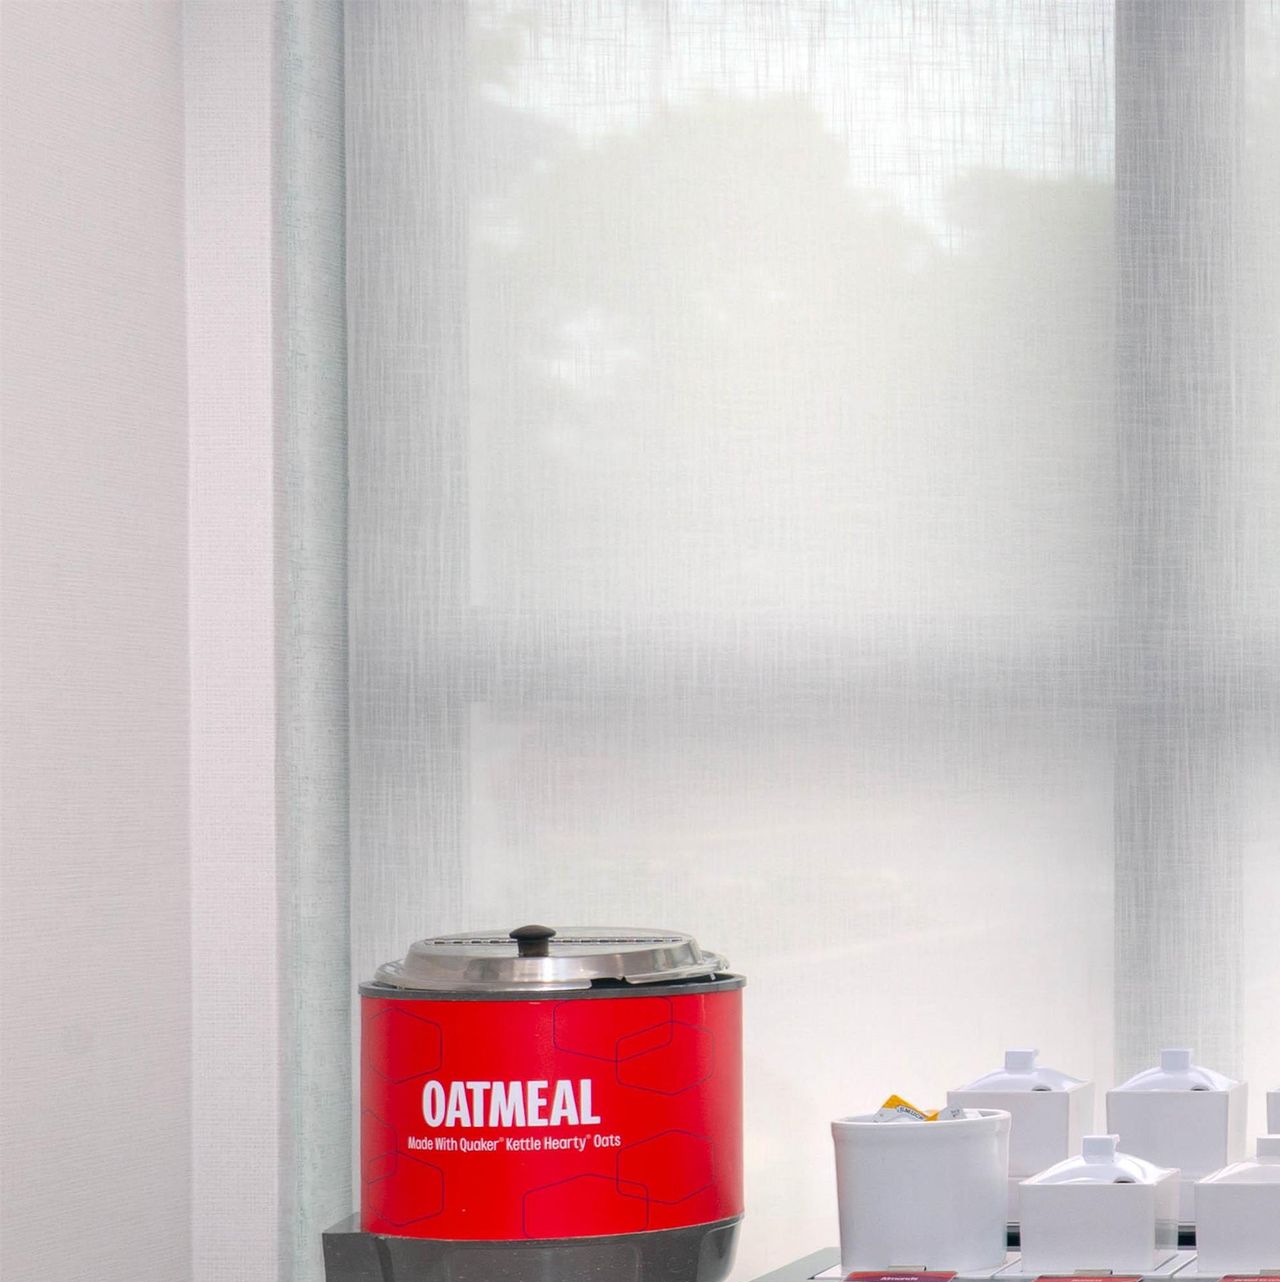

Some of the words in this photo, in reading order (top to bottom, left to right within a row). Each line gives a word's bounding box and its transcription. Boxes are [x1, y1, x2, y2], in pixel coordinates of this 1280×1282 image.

[421, 1078, 602, 1128] OATMEAL
[408, 1136, 434, 1150] Made
[435, 1137, 458, 1150] With
[459, 1137, 499, 1152] Quaker
[505, 1136, 541, 1151] Kettle
[544, 1135, 587, 1152] Hearty
[593, 1133, 621, 1148] Oats
